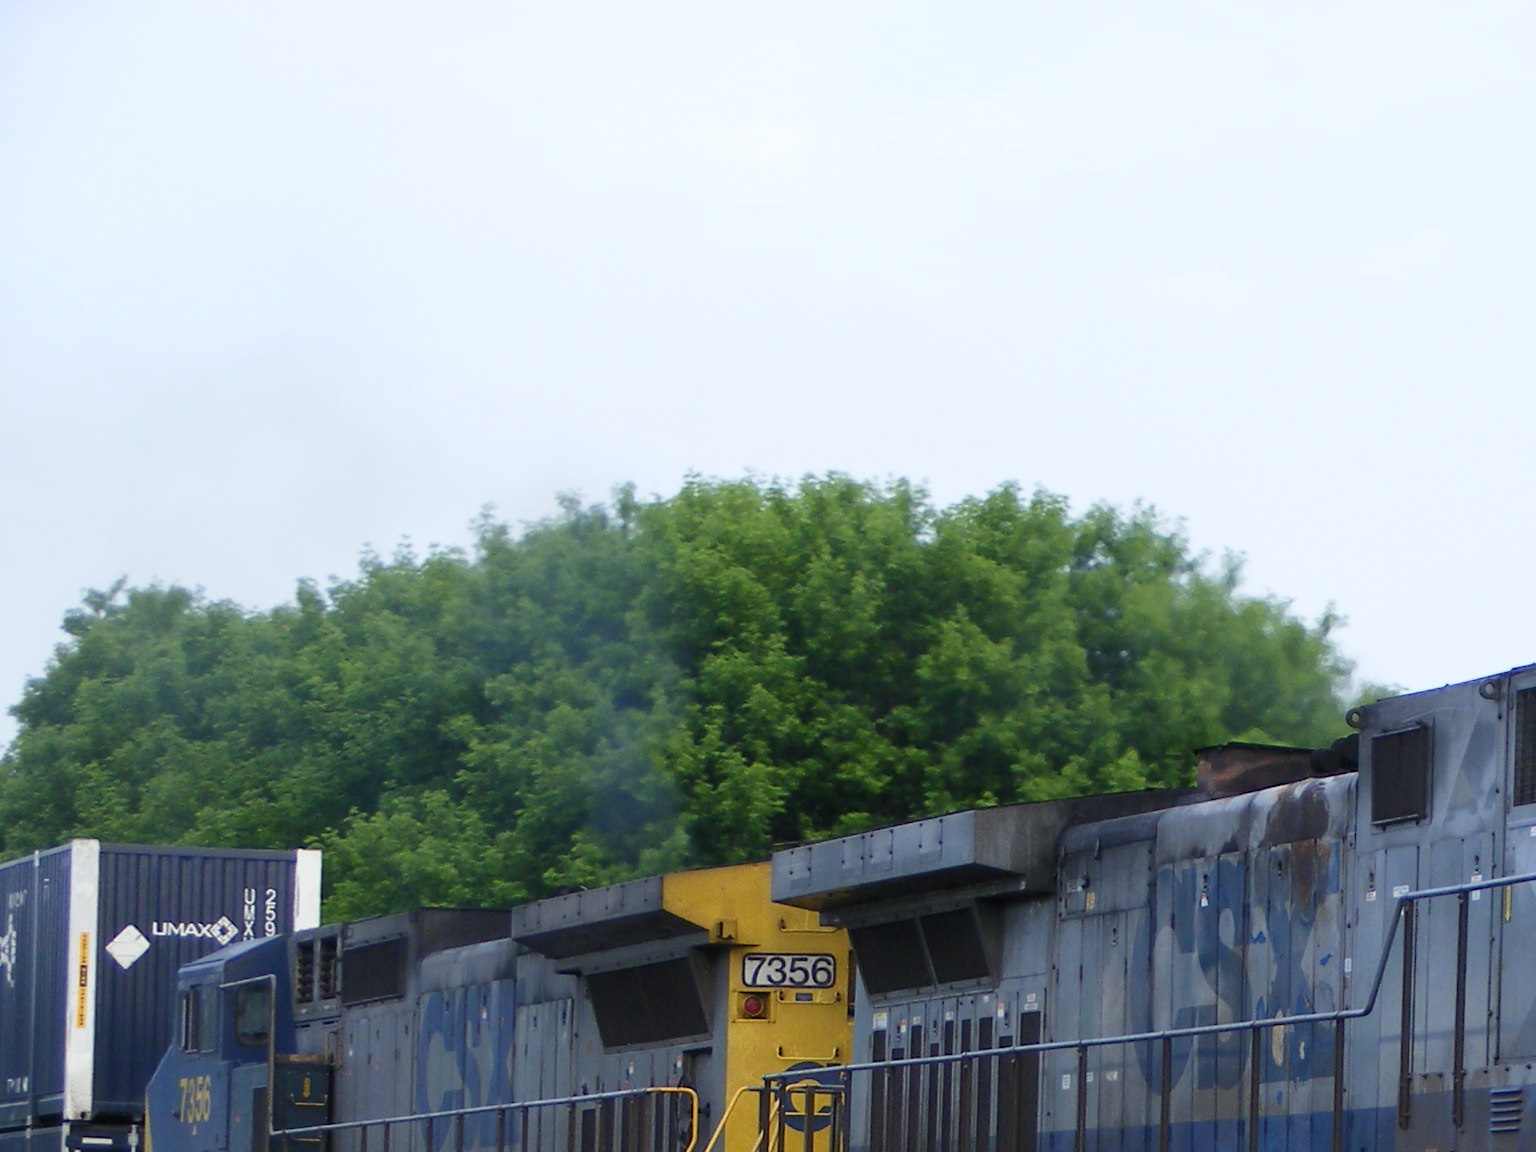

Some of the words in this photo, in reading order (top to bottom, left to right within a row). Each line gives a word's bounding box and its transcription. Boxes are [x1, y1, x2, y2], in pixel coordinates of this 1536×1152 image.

[152, 921, 213, 939] UMAX
[243, 888, 256, 942] UMX
[747, 956, 832, 986] 7356
[1130, 846, 1341, 1097] CSX
[179, 1075, 212, 1124] 7356
